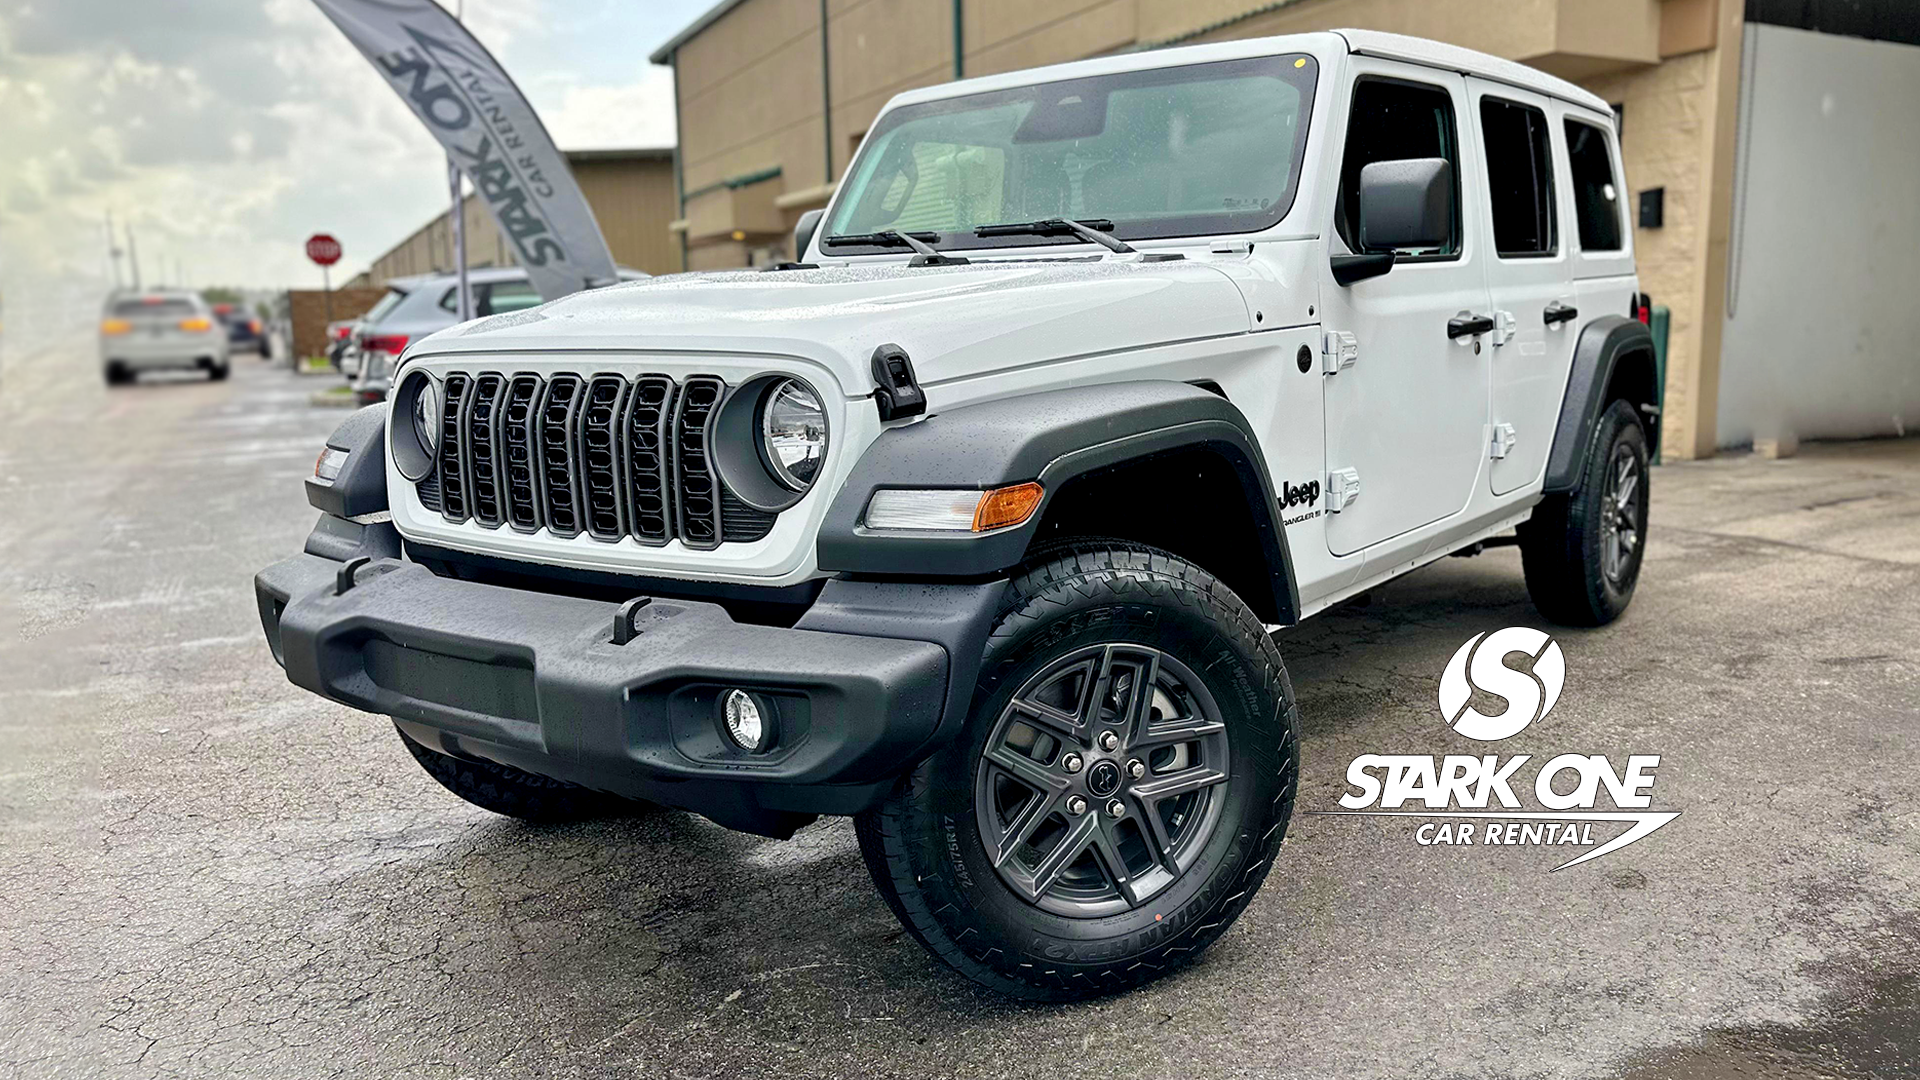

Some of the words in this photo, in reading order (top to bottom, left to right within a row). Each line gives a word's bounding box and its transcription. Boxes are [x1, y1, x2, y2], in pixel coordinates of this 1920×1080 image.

[376, 46, 472, 131] ONE
[453, 133, 566, 267] STARK
[518, 154, 554, 198] CAR
[308, 241, 340, 258] STOP
[1277, 479, 1320, 510] Jeep
[1283, 511, 1315, 527] RANGLER
[1219, 649, 1261, 718] All-Weather
[944, 815, 974, 888] 245/75R17
